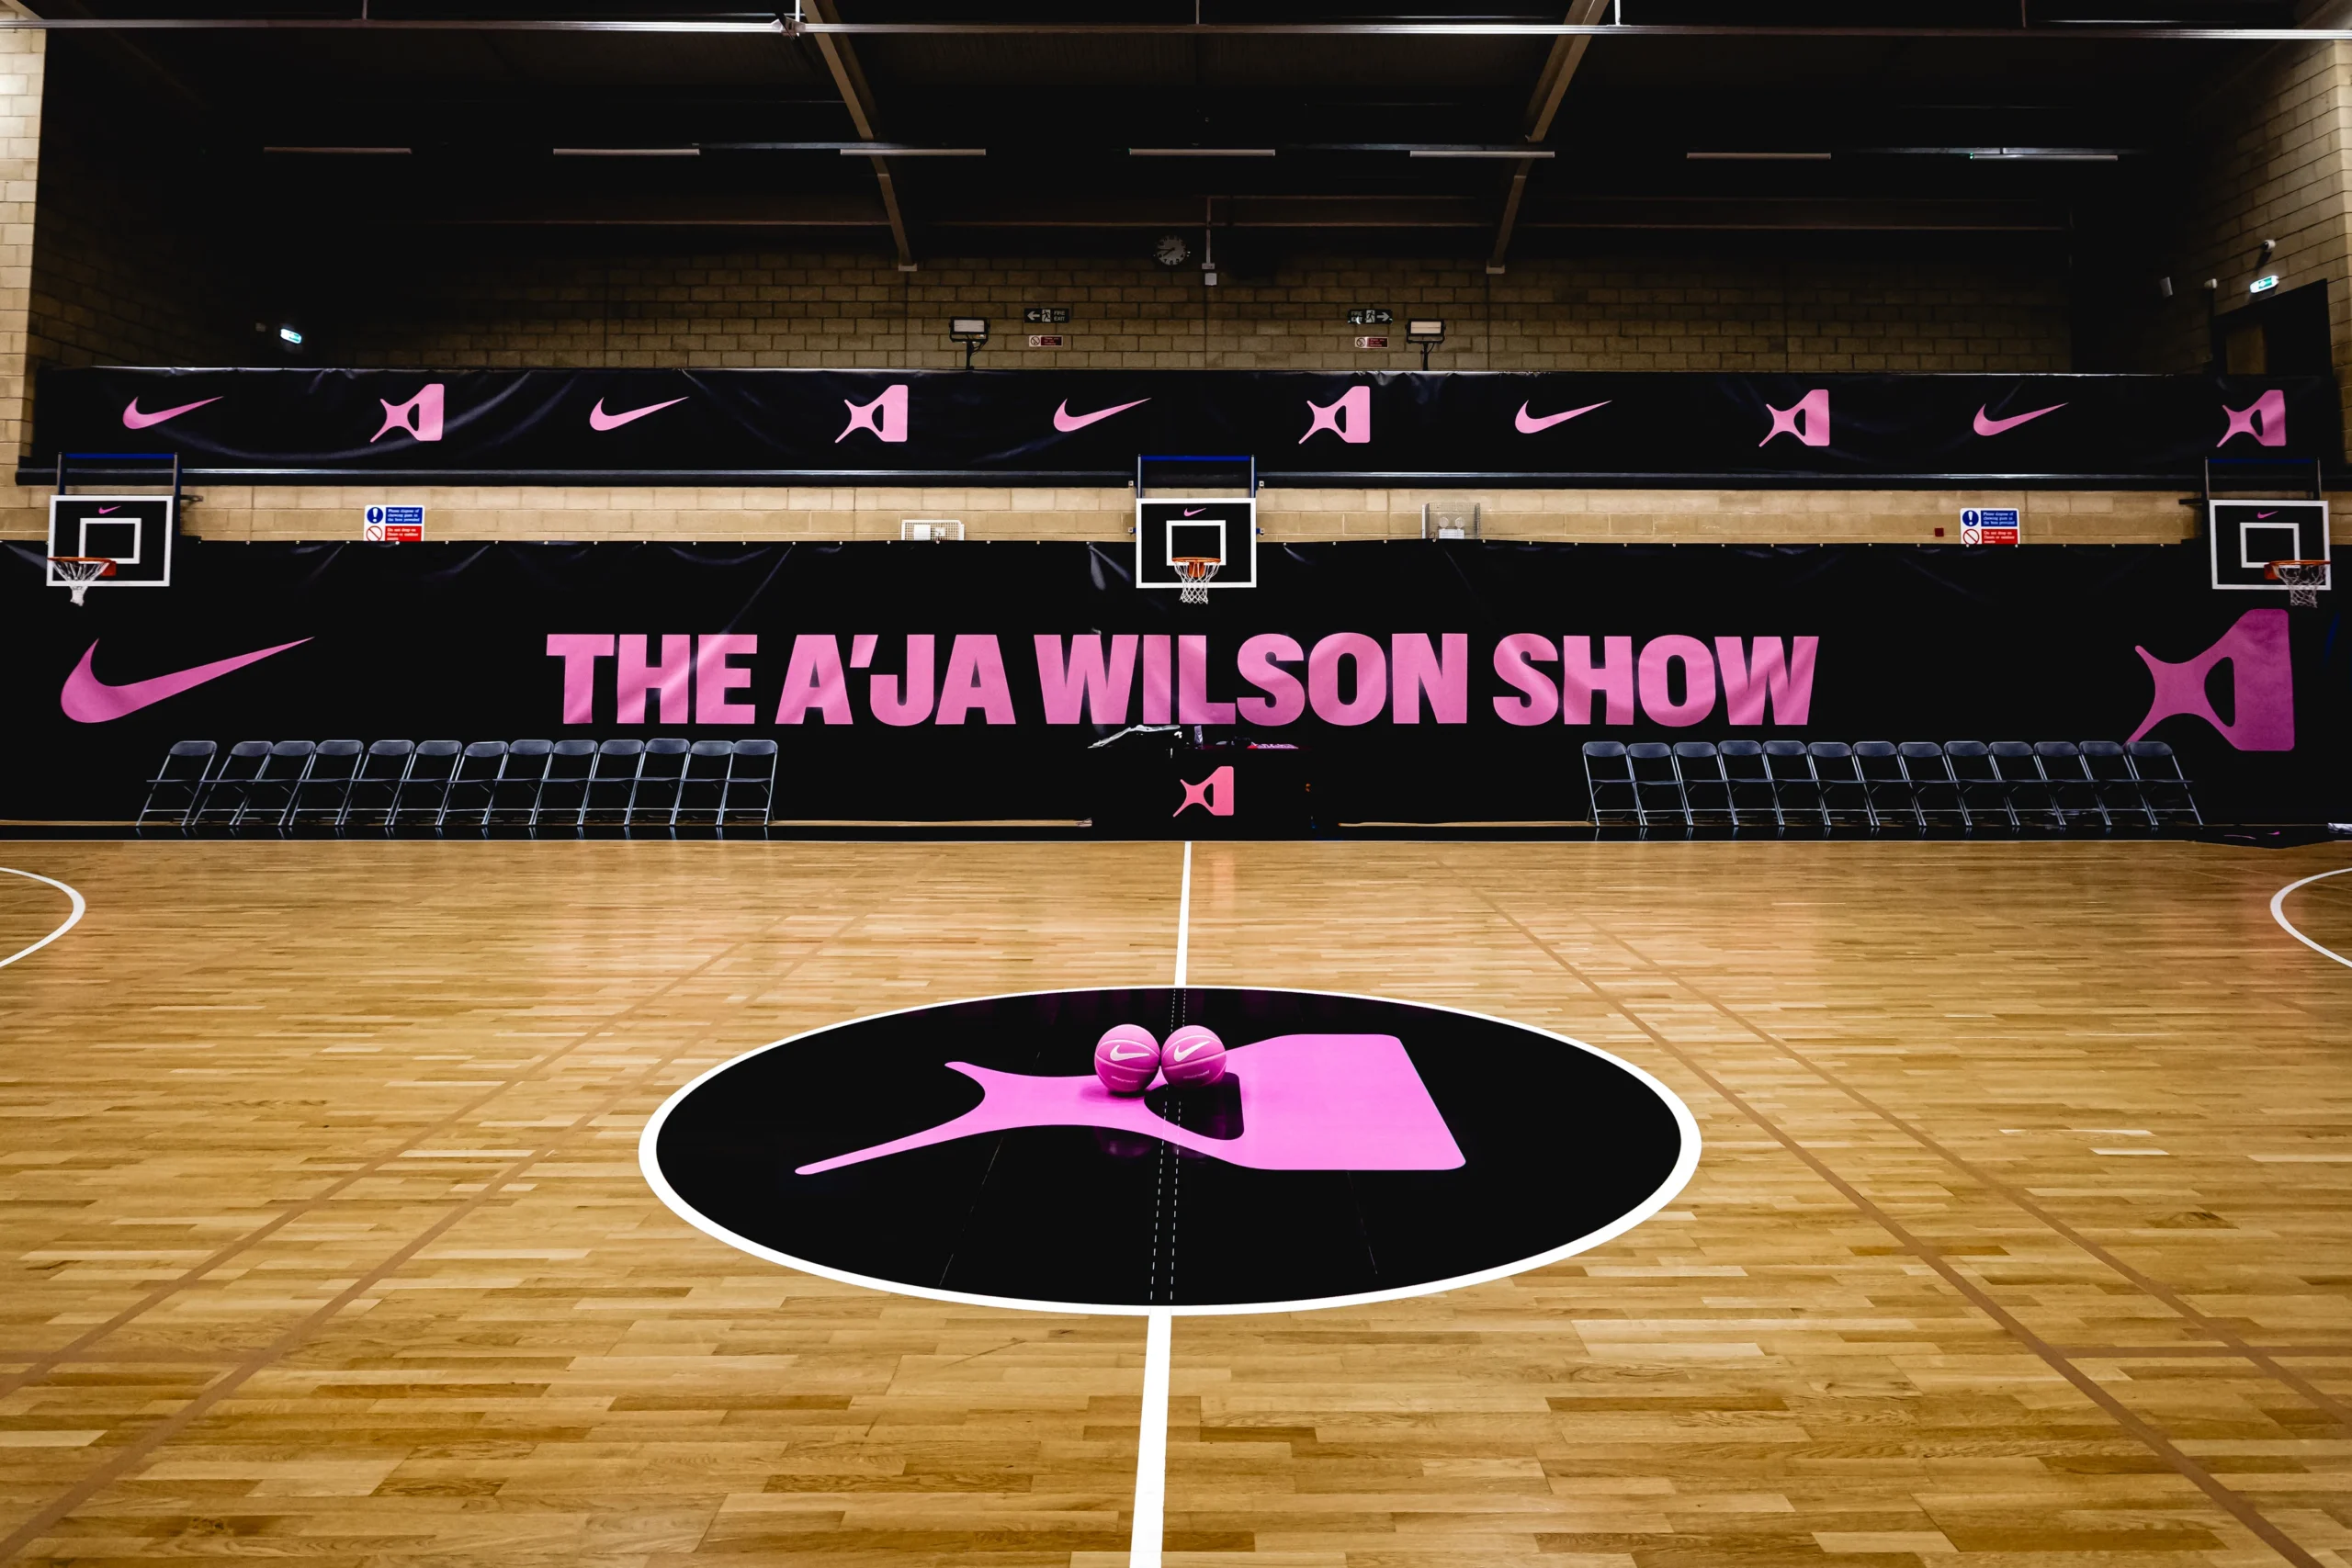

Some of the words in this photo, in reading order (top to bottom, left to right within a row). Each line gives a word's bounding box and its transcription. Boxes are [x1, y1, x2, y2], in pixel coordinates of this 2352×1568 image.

[546, 634, 757, 724] THE
[775, 634, 1016, 726] A'JA
[1034, 631, 1467, 726] WILSON
[1493, 634, 1820, 727] SHOW
